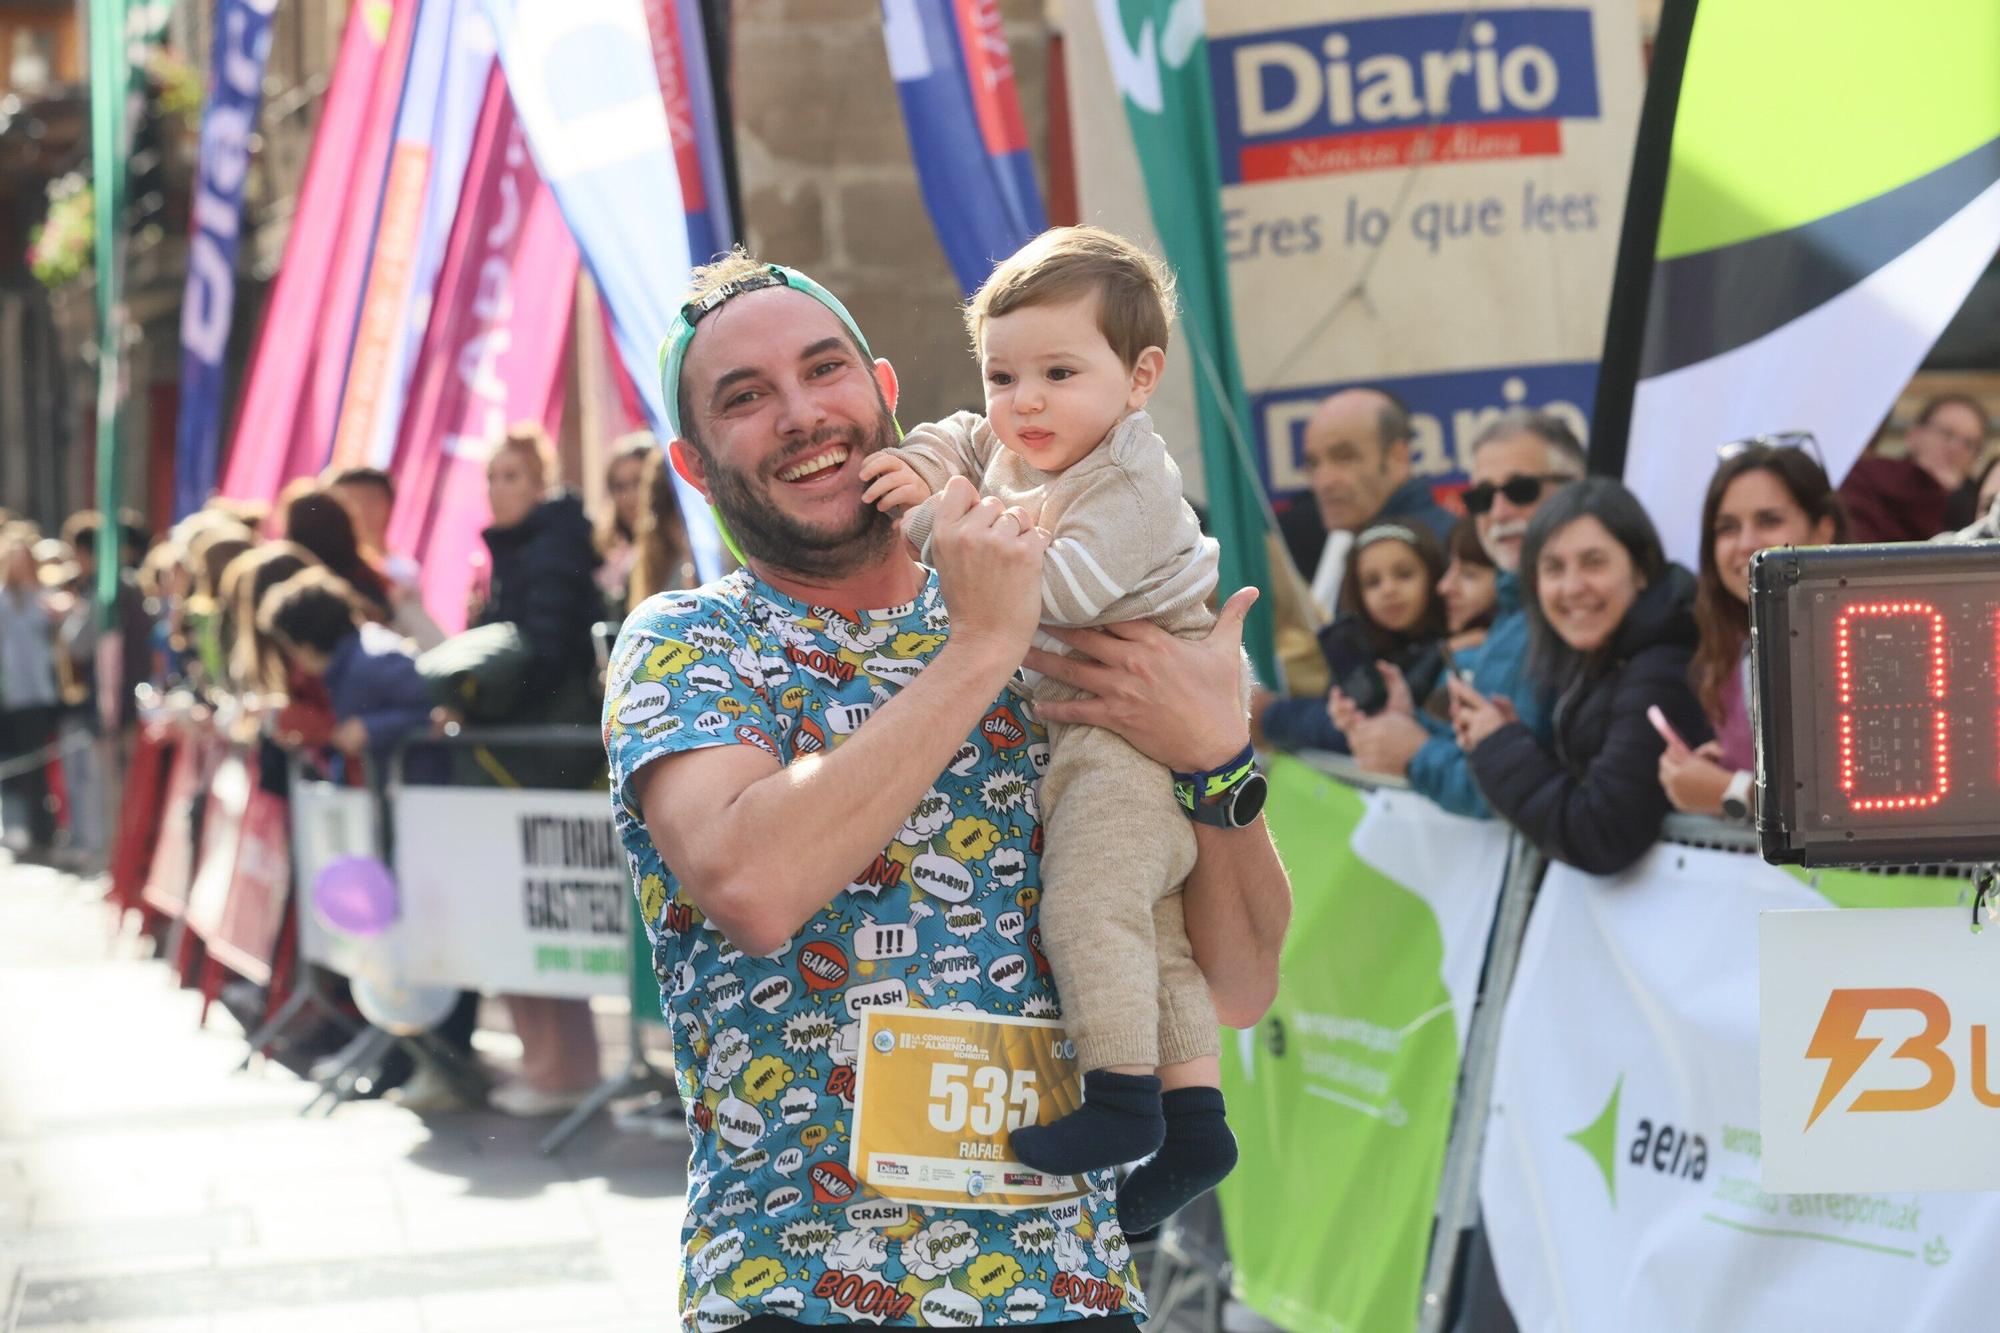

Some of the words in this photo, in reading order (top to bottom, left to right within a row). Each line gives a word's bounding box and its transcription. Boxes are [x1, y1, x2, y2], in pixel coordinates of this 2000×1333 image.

[1234, 20, 1558, 137] Diario
[1222, 207, 1322, 262] Eres
[1345, 196, 1391, 249] lo
[1411, 197, 1506, 257] que
[1522, 180, 1600, 234] lees
[699, 714, 723, 728] HA!
[984, 717, 1023, 742] BAM!!!
[913, 865, 970, 894] SPLASH!
[998, 914, 1022, 932] HA!
[801, 950, 846, 982] BAM!!!
[851, 989, 903, 1011] CRASH
[927, 1062, 1040, 1136] 535
[719, 1112, 762, 1138] SPLASH!
[806, 1129, 822, 1140] HA!
[777, 1152, 799, 1167] HA!
[959, 1142, 1005, 1161] RAFAEL
[812, 1168, 852, 1197] BAM!!!
[851, 1206, 904, 1221] CRASH
[1052, 1204, 1079, 1221] CRASH
[927, 1231, 972, 1262] POOF
[813, 1269, 915, 1320] BOOM
[1051, 1271, 1124, 1312] BOOM
[923, 1300, 979, 1327] SPLASH!
